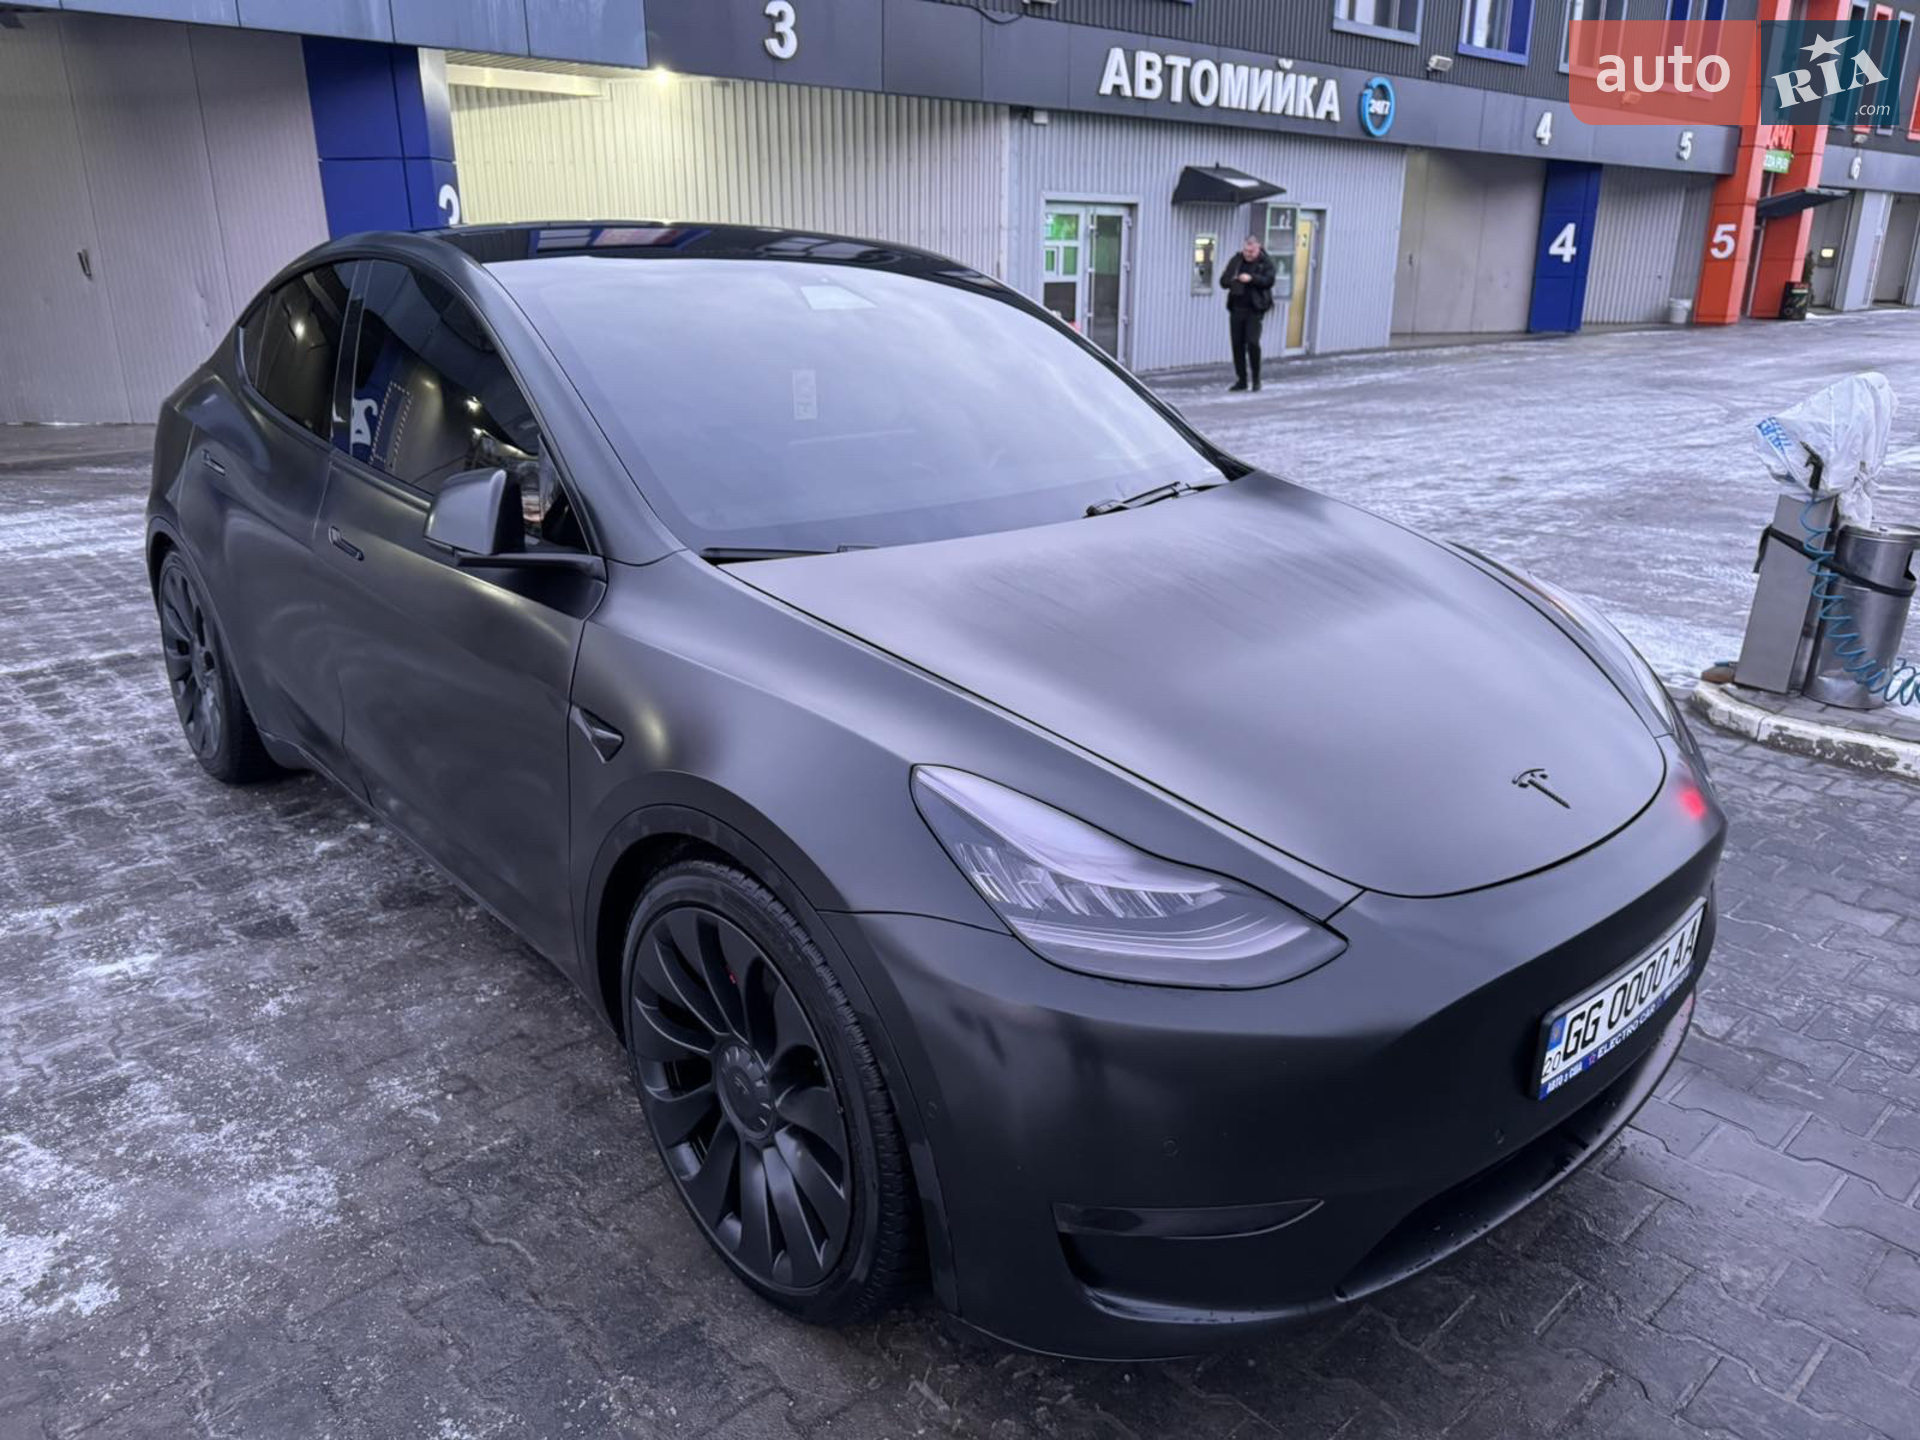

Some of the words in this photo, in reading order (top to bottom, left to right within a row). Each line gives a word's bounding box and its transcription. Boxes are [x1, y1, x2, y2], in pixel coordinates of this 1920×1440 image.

[764, 0, 798, 59] 3
[1099, 47, 1341, 123] АВТОМИЙКА
[1536, 111, 1552, 146] 4
[1677, 130, 1693, 160] 5
[1850, 156, 1862, 180] 6
[1548, 222, 1577, 263] 4
[1710, 223, 1737, 260] 5
[1562, 998, 1604, 1062] GG
[1607, 946, 1669, 1030] 0000
[1669, 918, 1699, 978] AA
[1596, 1019, 1639, 1059] ELECTRO
[1542, 1051, 1561, 1077] 20
